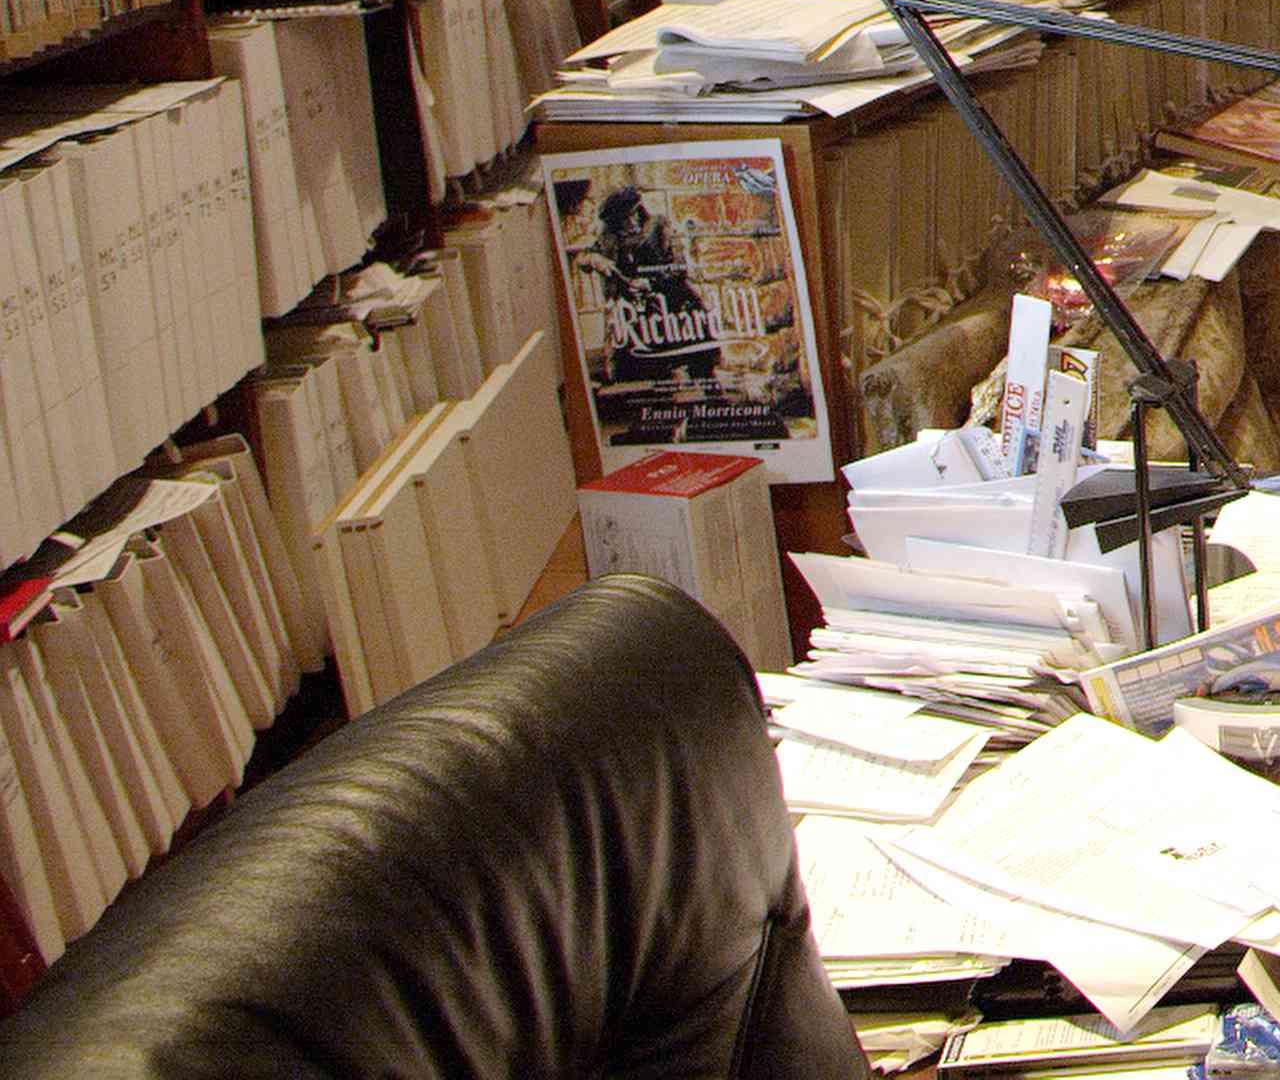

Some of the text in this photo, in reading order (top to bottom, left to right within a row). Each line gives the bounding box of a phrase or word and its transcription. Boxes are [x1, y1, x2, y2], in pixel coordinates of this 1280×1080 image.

[607, 284, 722, 351] Richard
[641, 403, 771, 421] Ennio Morricone
